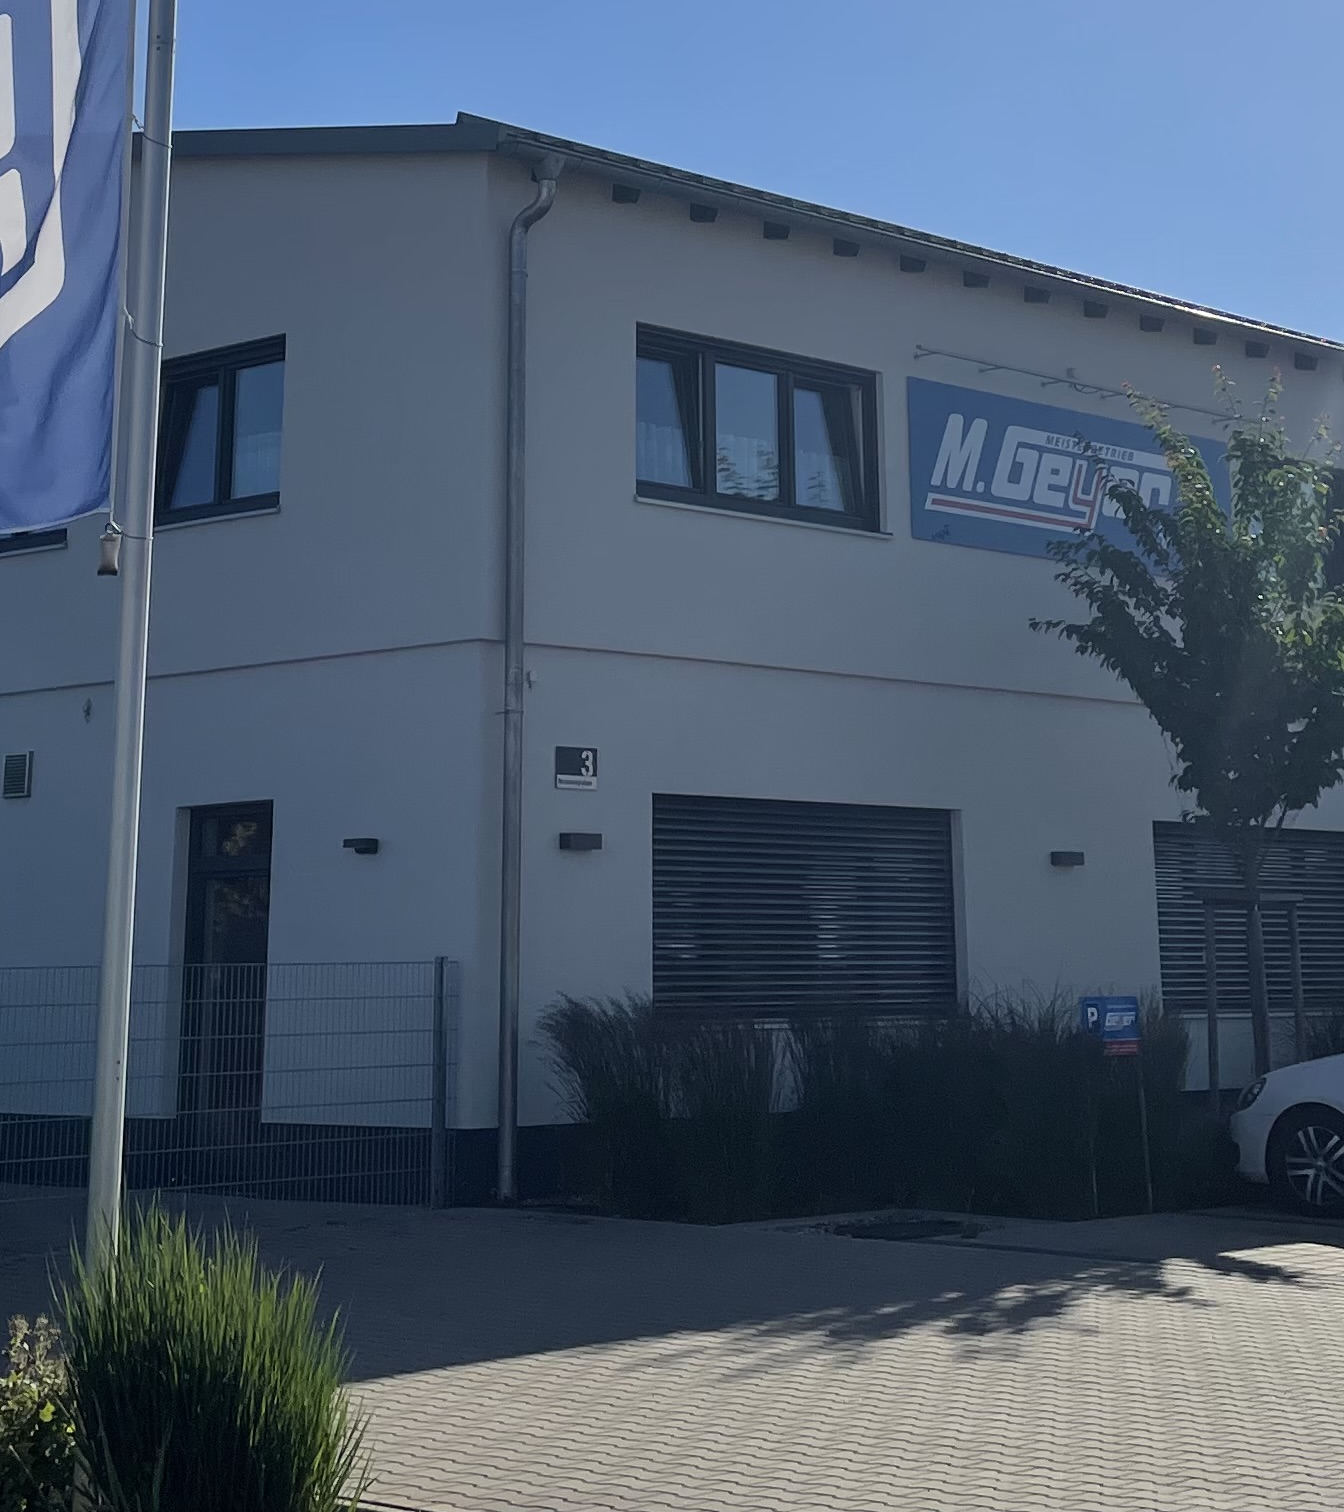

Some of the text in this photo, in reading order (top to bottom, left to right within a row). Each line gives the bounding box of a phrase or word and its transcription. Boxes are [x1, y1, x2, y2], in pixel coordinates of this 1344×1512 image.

[1044, 434, 1135, 462] MEISTEBETRIEB
[581, 750, 594, 777] 3
[1087, 1007, 1098, 1028] P
